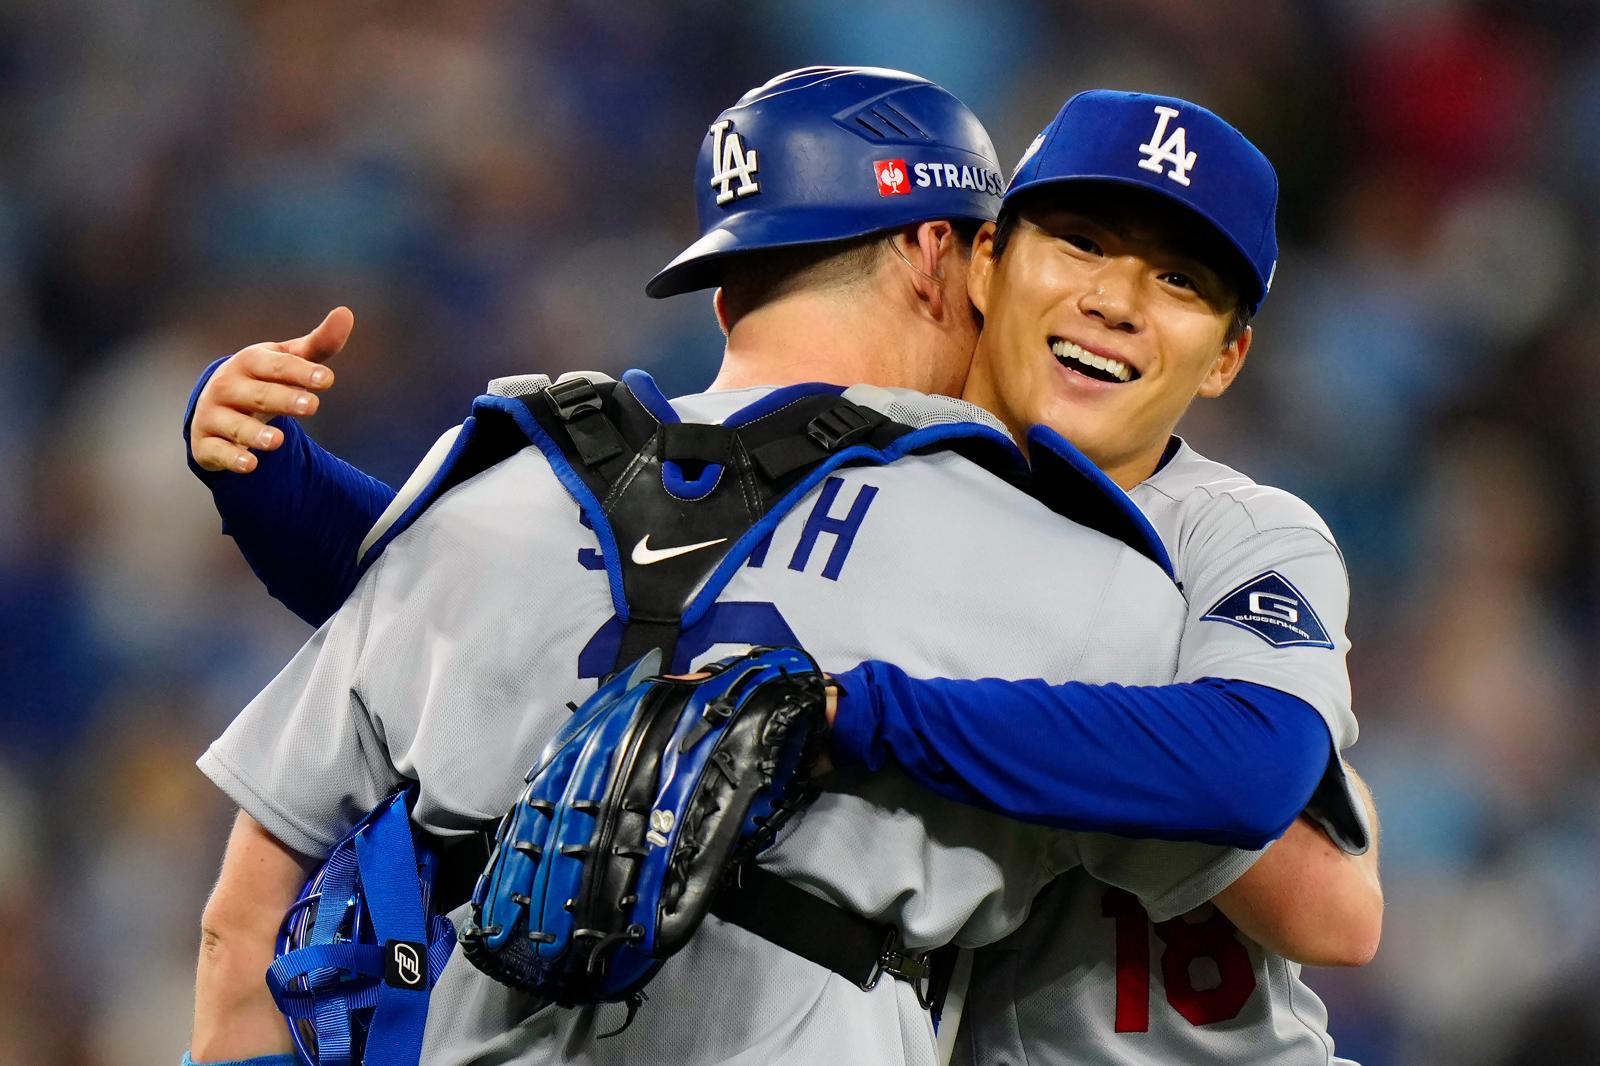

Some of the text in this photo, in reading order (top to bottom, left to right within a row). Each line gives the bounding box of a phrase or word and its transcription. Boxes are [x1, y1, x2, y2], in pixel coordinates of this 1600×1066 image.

[710, 120, 758, 205] LA
[1138, 105, 1197, 187] LA
[913, 162, 1004, 199] STRAUSS
[1235, 614, 1310, 640] GUGGENHEIM
[646, 808, 675, 848] 18
[1101, 885, 1257, 1033] 18
